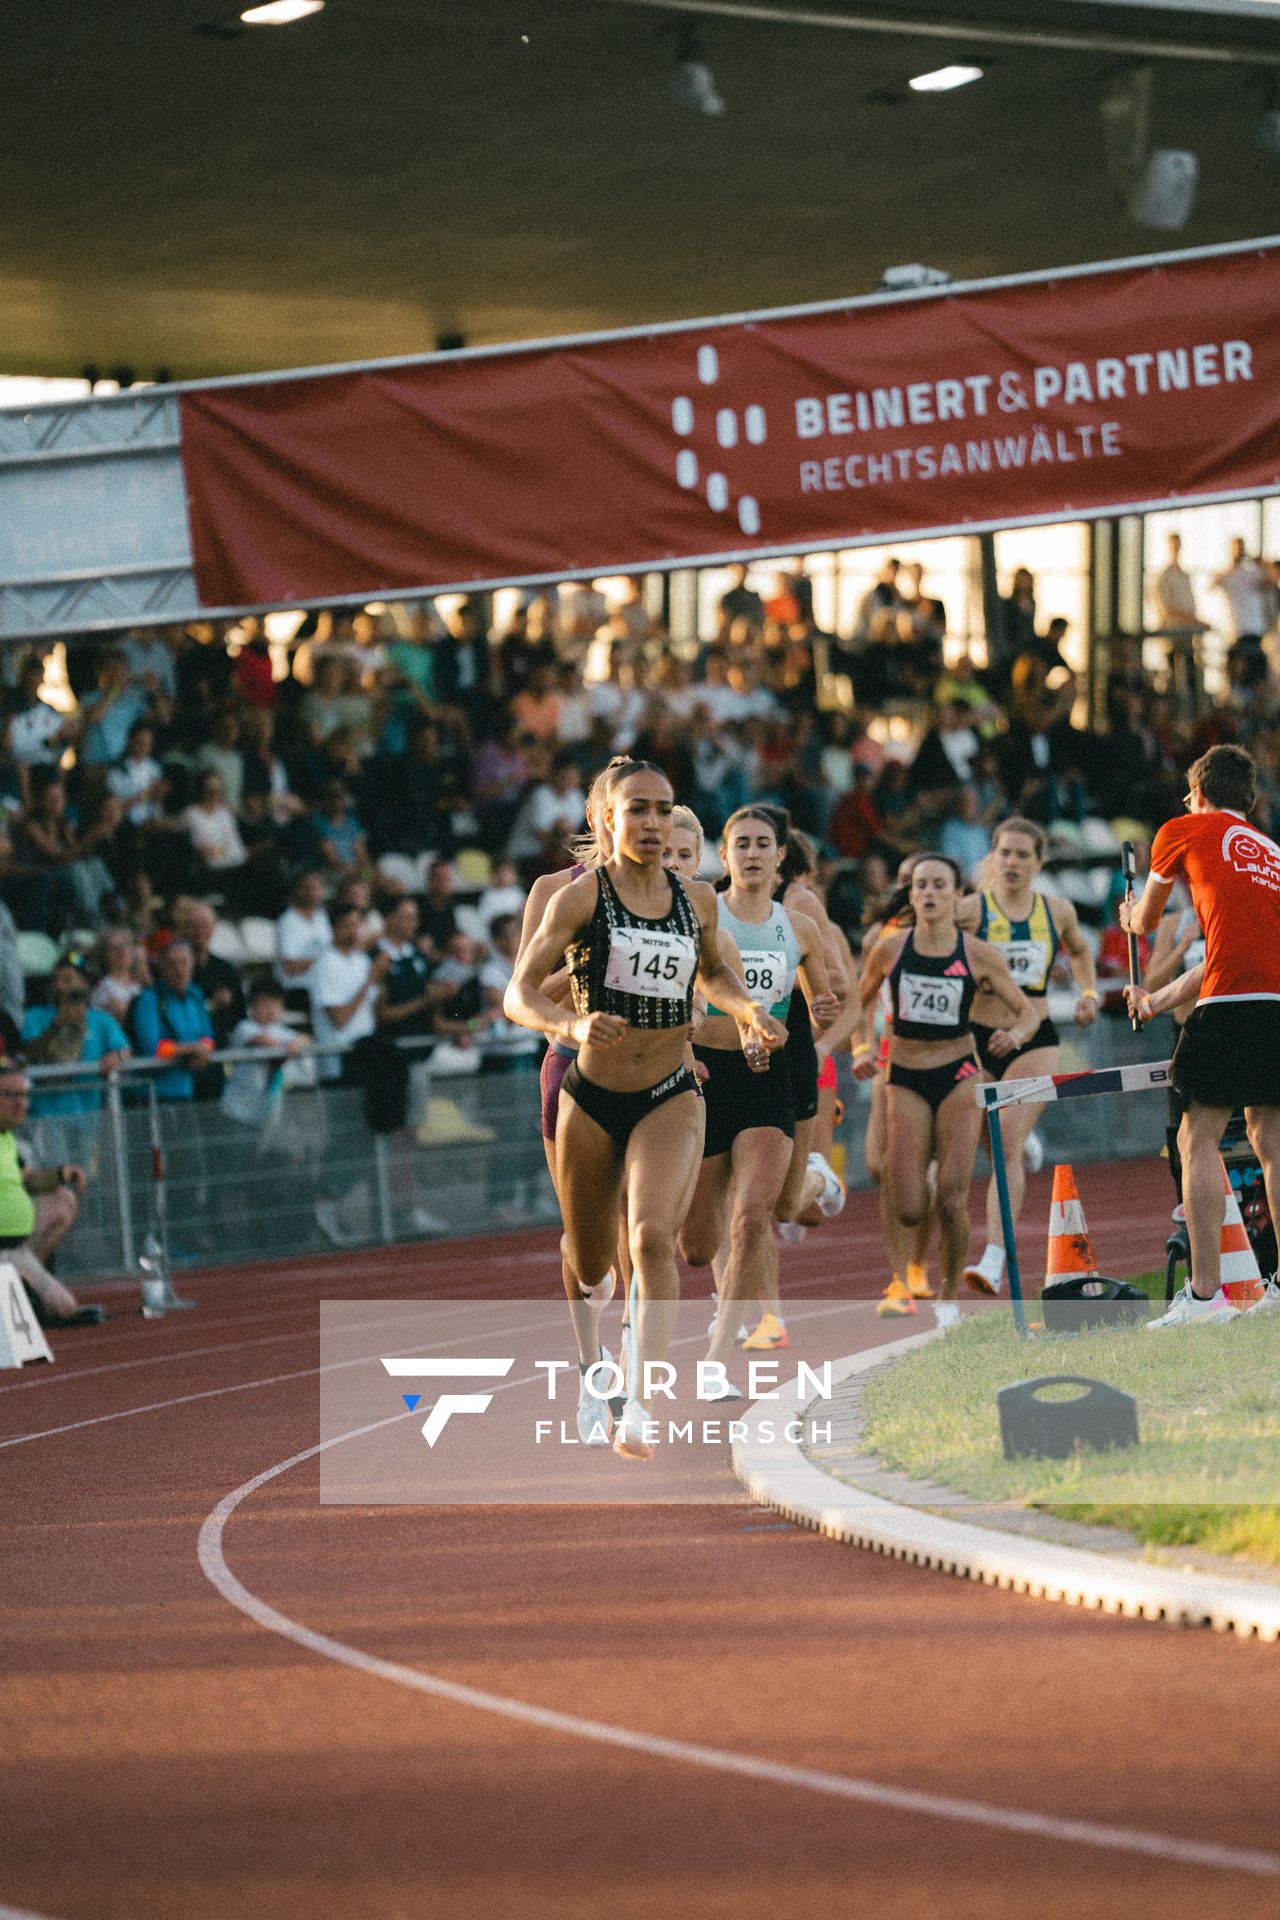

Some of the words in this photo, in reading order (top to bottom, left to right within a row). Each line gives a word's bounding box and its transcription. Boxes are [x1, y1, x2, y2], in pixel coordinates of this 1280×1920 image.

[799, 421, 1122, 494] RECHTSANWÄLTE
[1233, 861, 1280, 882] Laufn
[1264, 854, 1280, 870] La
[628, 951, 680, 980] 145
[745, 968, 773, 990] 98
[910, 991, 949, 1013] 749
[651, 1075, 676, 1100] NIKE
[8, 1280, 33, 1345] 4
